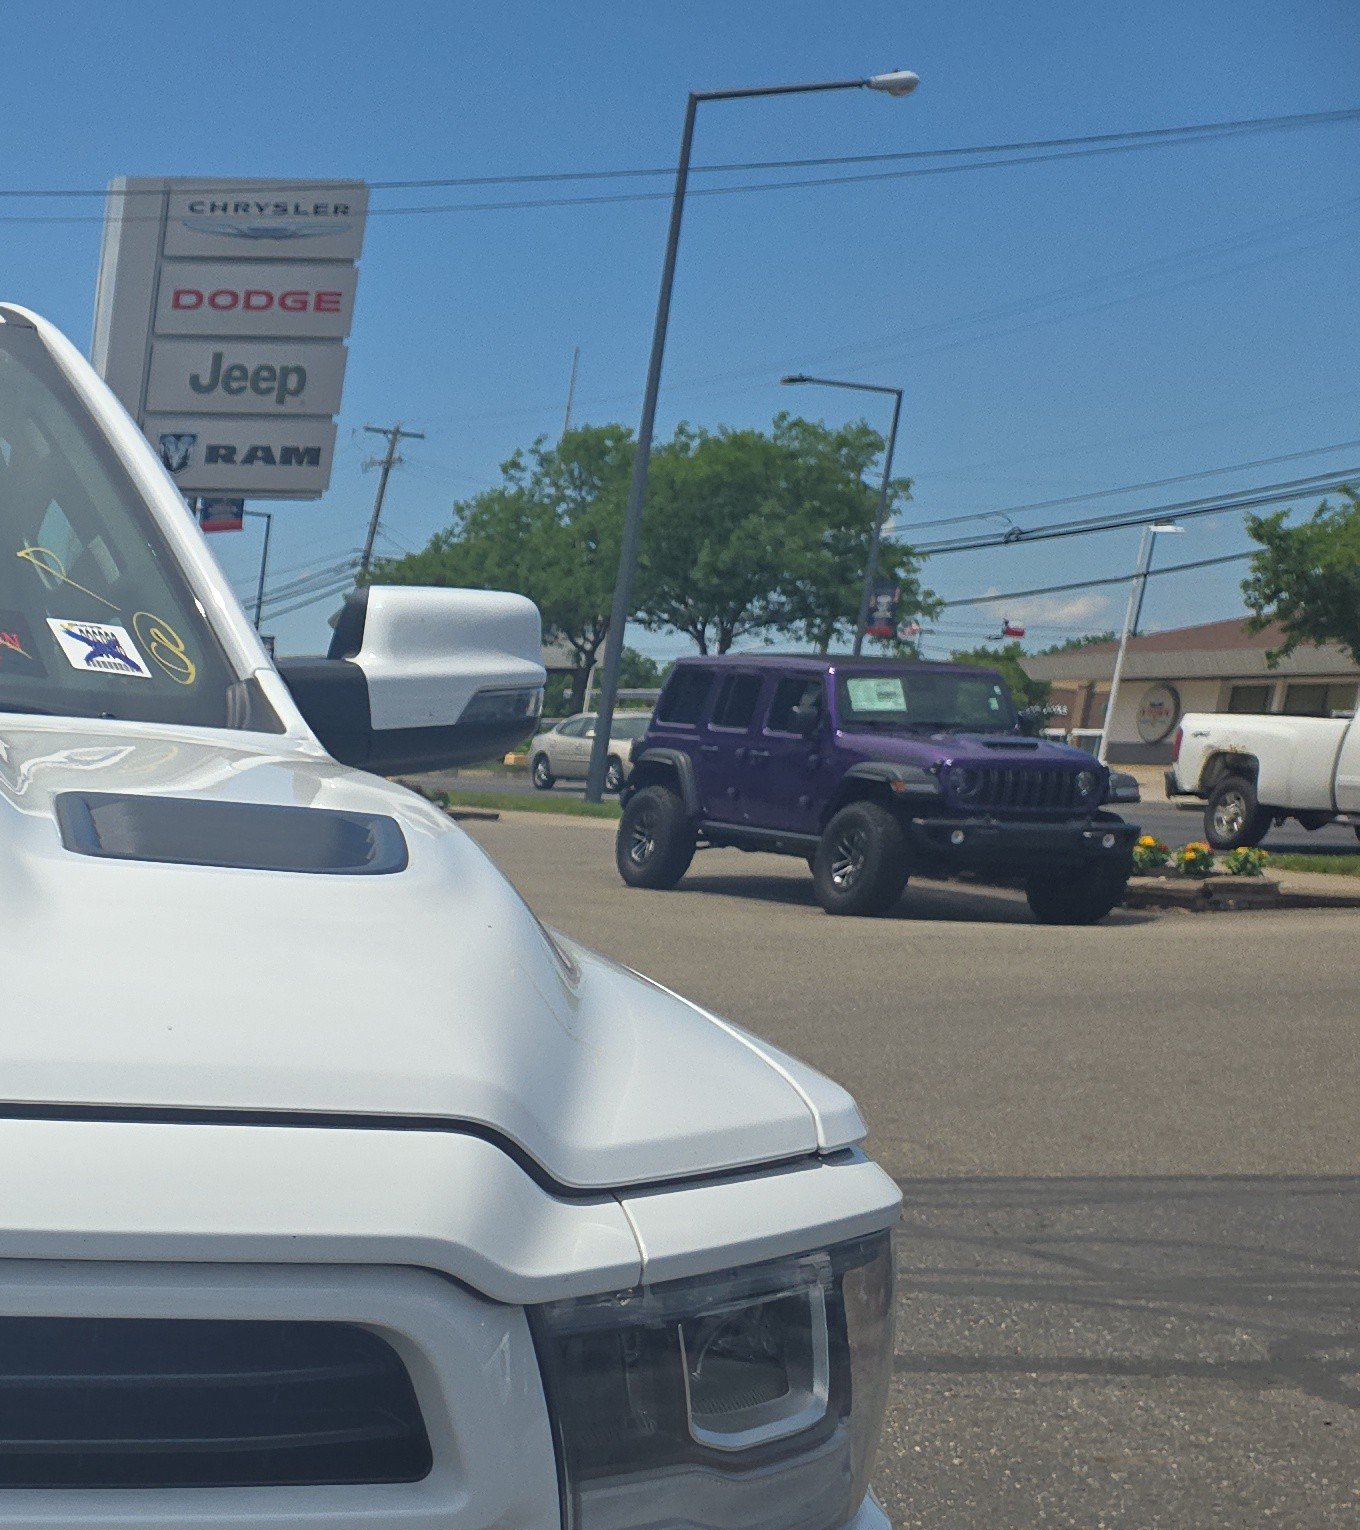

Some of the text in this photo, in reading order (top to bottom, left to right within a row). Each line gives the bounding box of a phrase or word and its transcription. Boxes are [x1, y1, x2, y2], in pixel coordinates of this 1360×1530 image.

[187, 200, 350, 216] CHRYSLER
[171, 288, 342, 312] DODGE
[188, 351, 307, 405] Jeep
[204, 444, 321, 467] RAM
